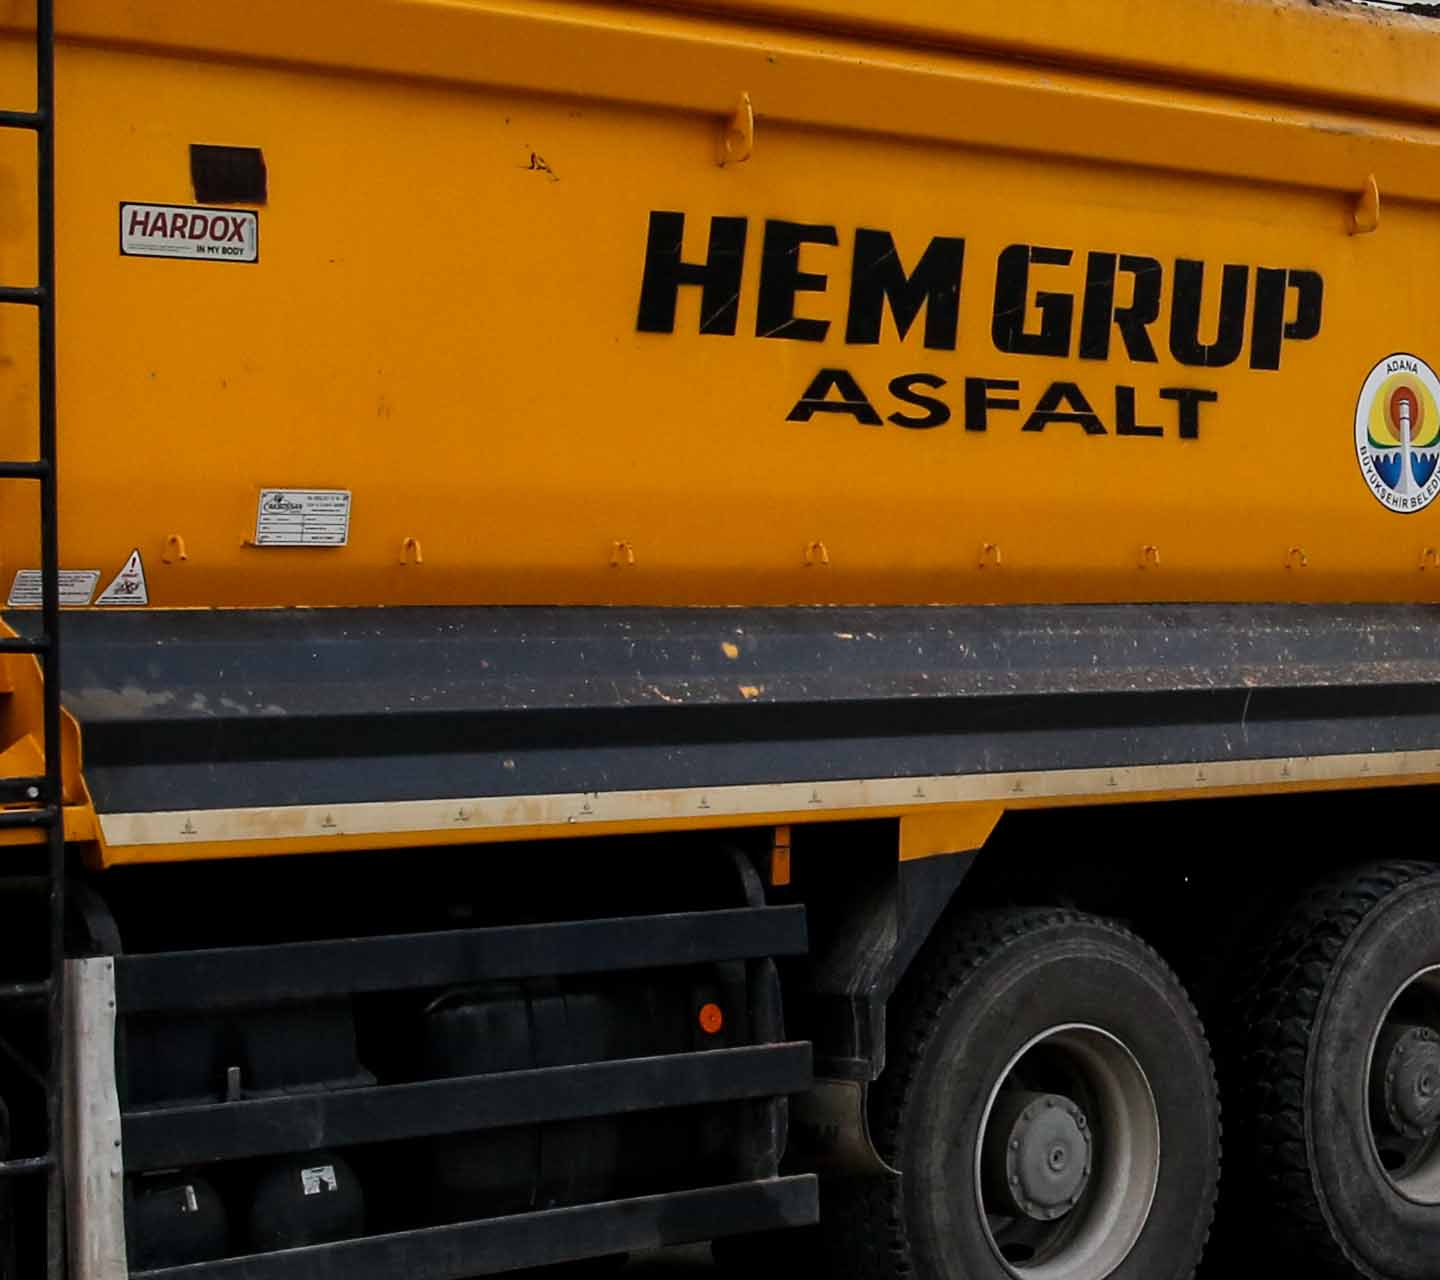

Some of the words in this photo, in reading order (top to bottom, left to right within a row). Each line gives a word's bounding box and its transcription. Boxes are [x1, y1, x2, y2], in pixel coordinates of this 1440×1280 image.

[128, 210, 247, 242] HARDOX
[196, 245, 205, 253] IN
[207, 246, 220, 255] MY
[222, 246, 245, 256] BODY
[636, 210, 965, 352] HEM
[990, 243, 1324, 372] GRUP
[1386, 360, 1418, 375] ADANA
[785, 369, 1219, 440] ASFALT
